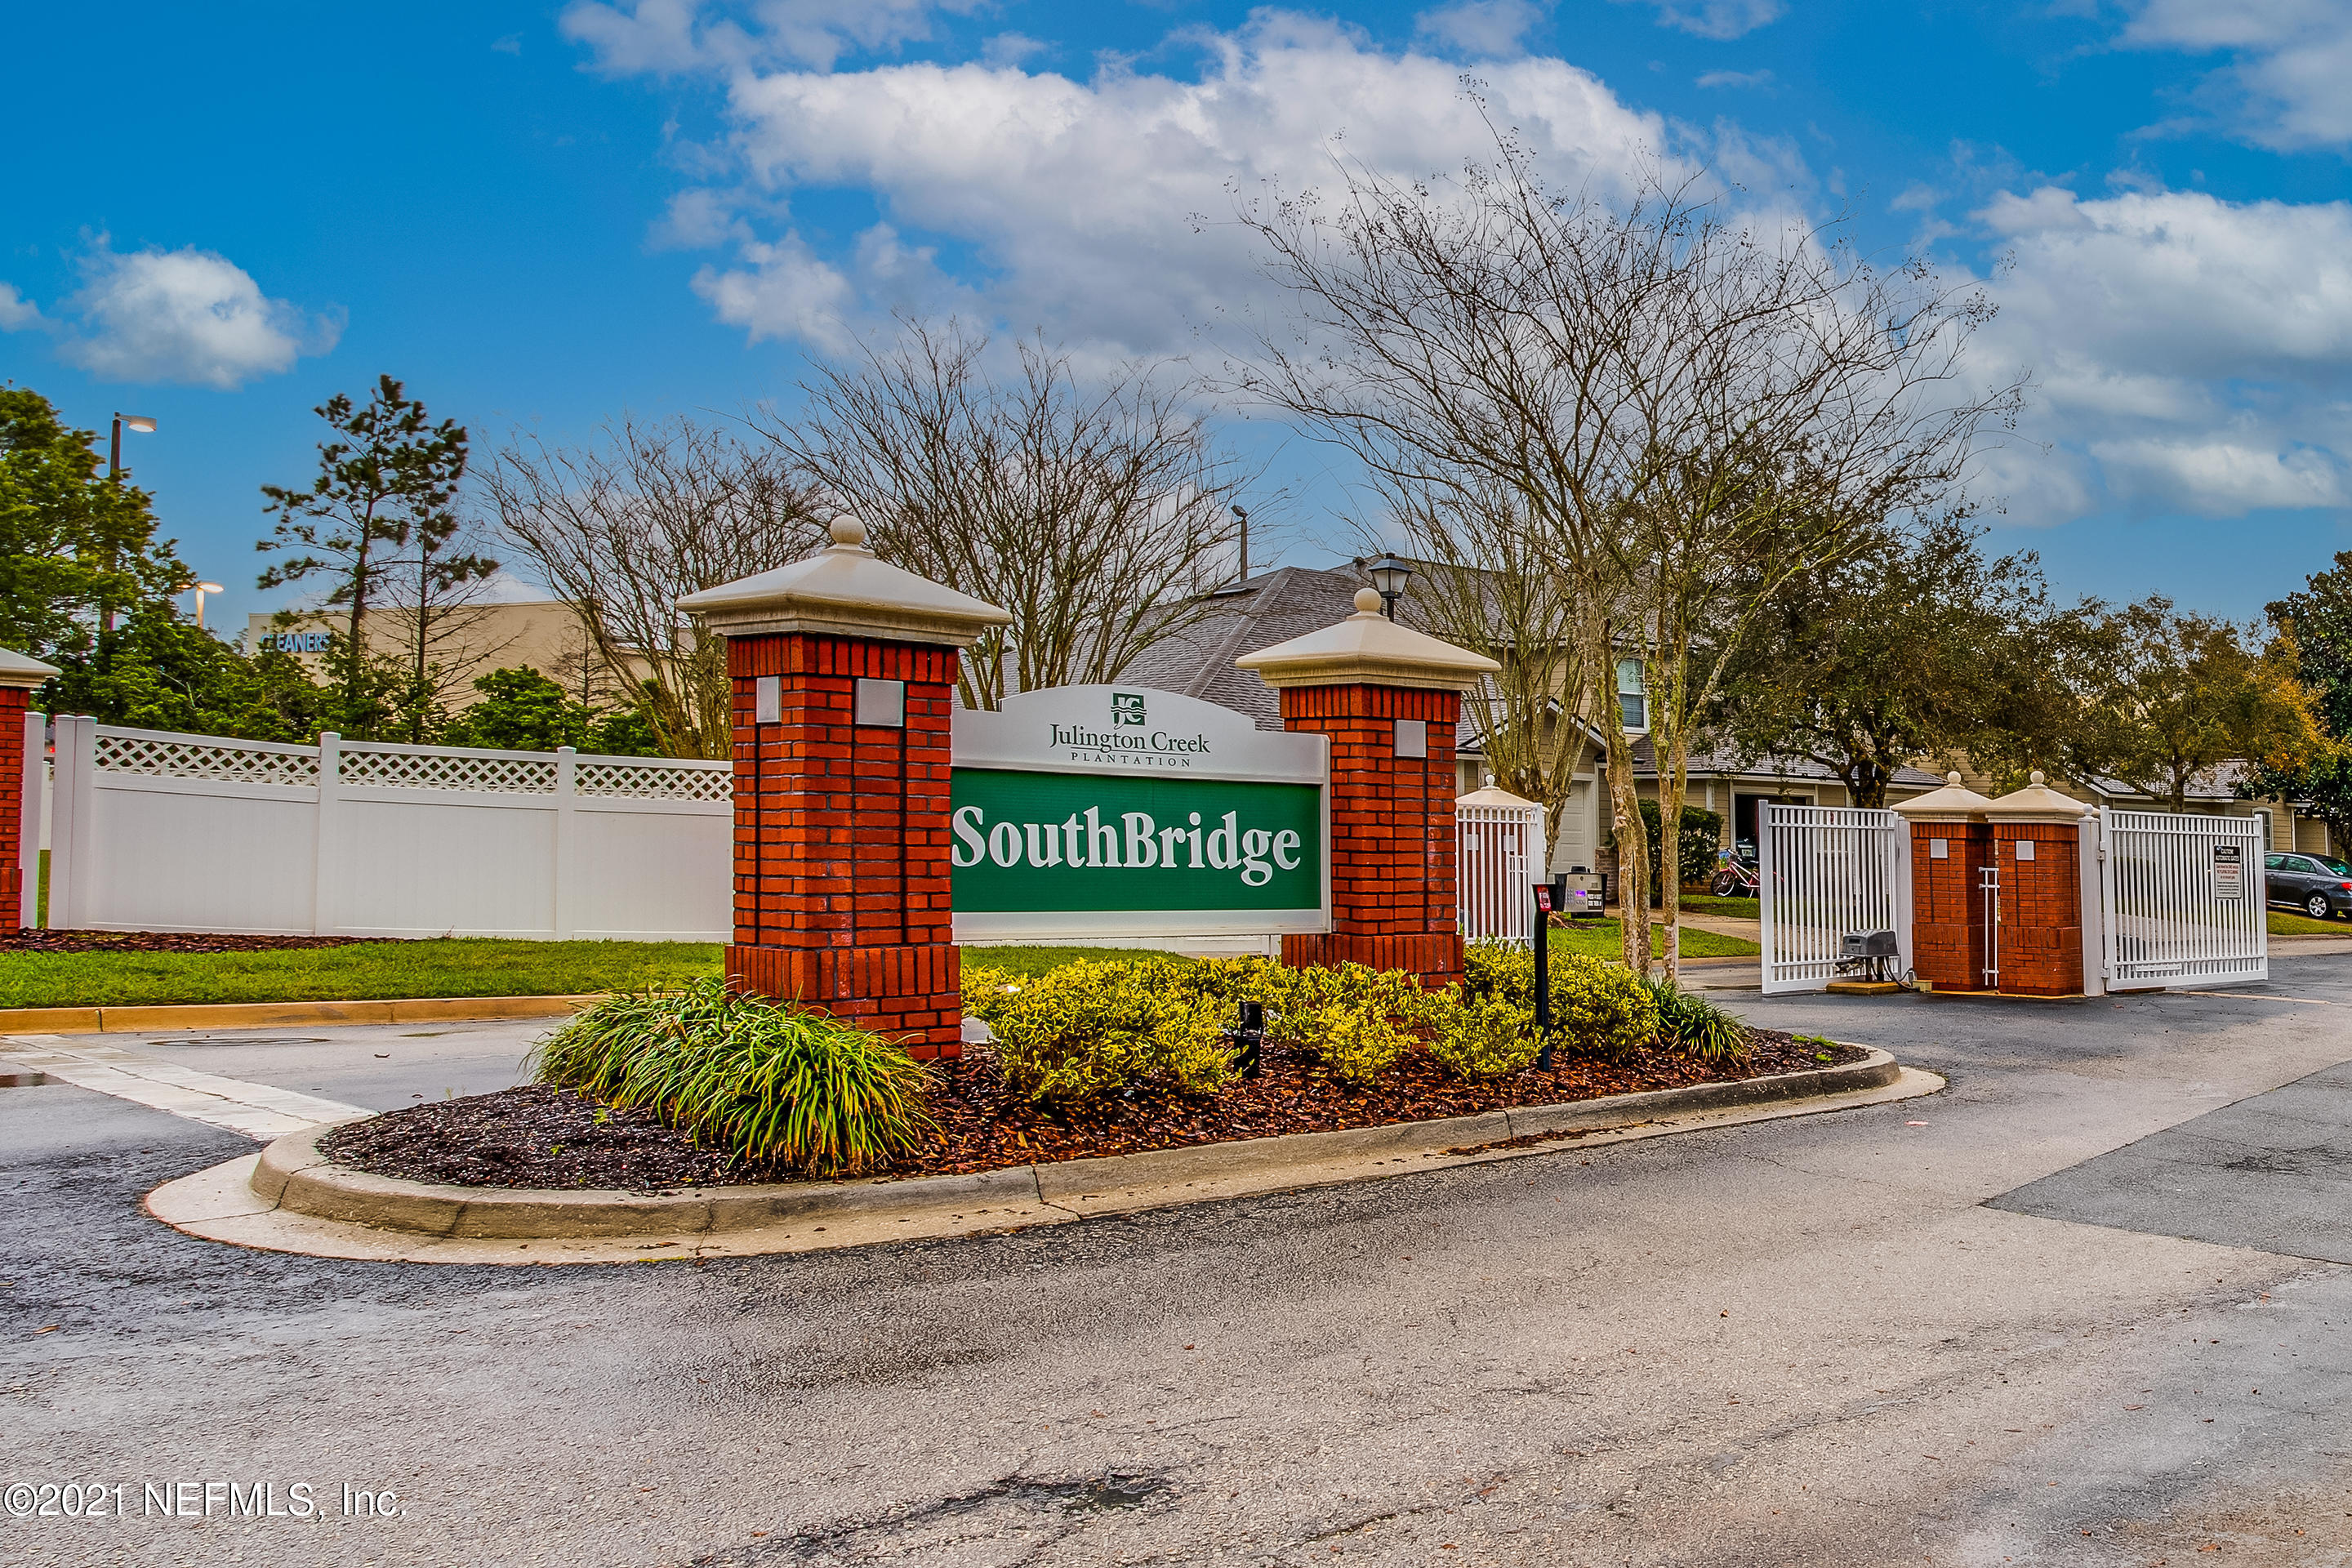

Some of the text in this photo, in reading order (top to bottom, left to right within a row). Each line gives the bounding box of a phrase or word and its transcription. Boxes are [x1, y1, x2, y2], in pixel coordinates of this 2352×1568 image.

[261, 632, 330, 652] CEANERS
[1049, 724, 1211, 753] Julington Creek
[1071, 752, 1191, 767] PLANTATION
[951, 805, 1301, 887] SouthBridge
